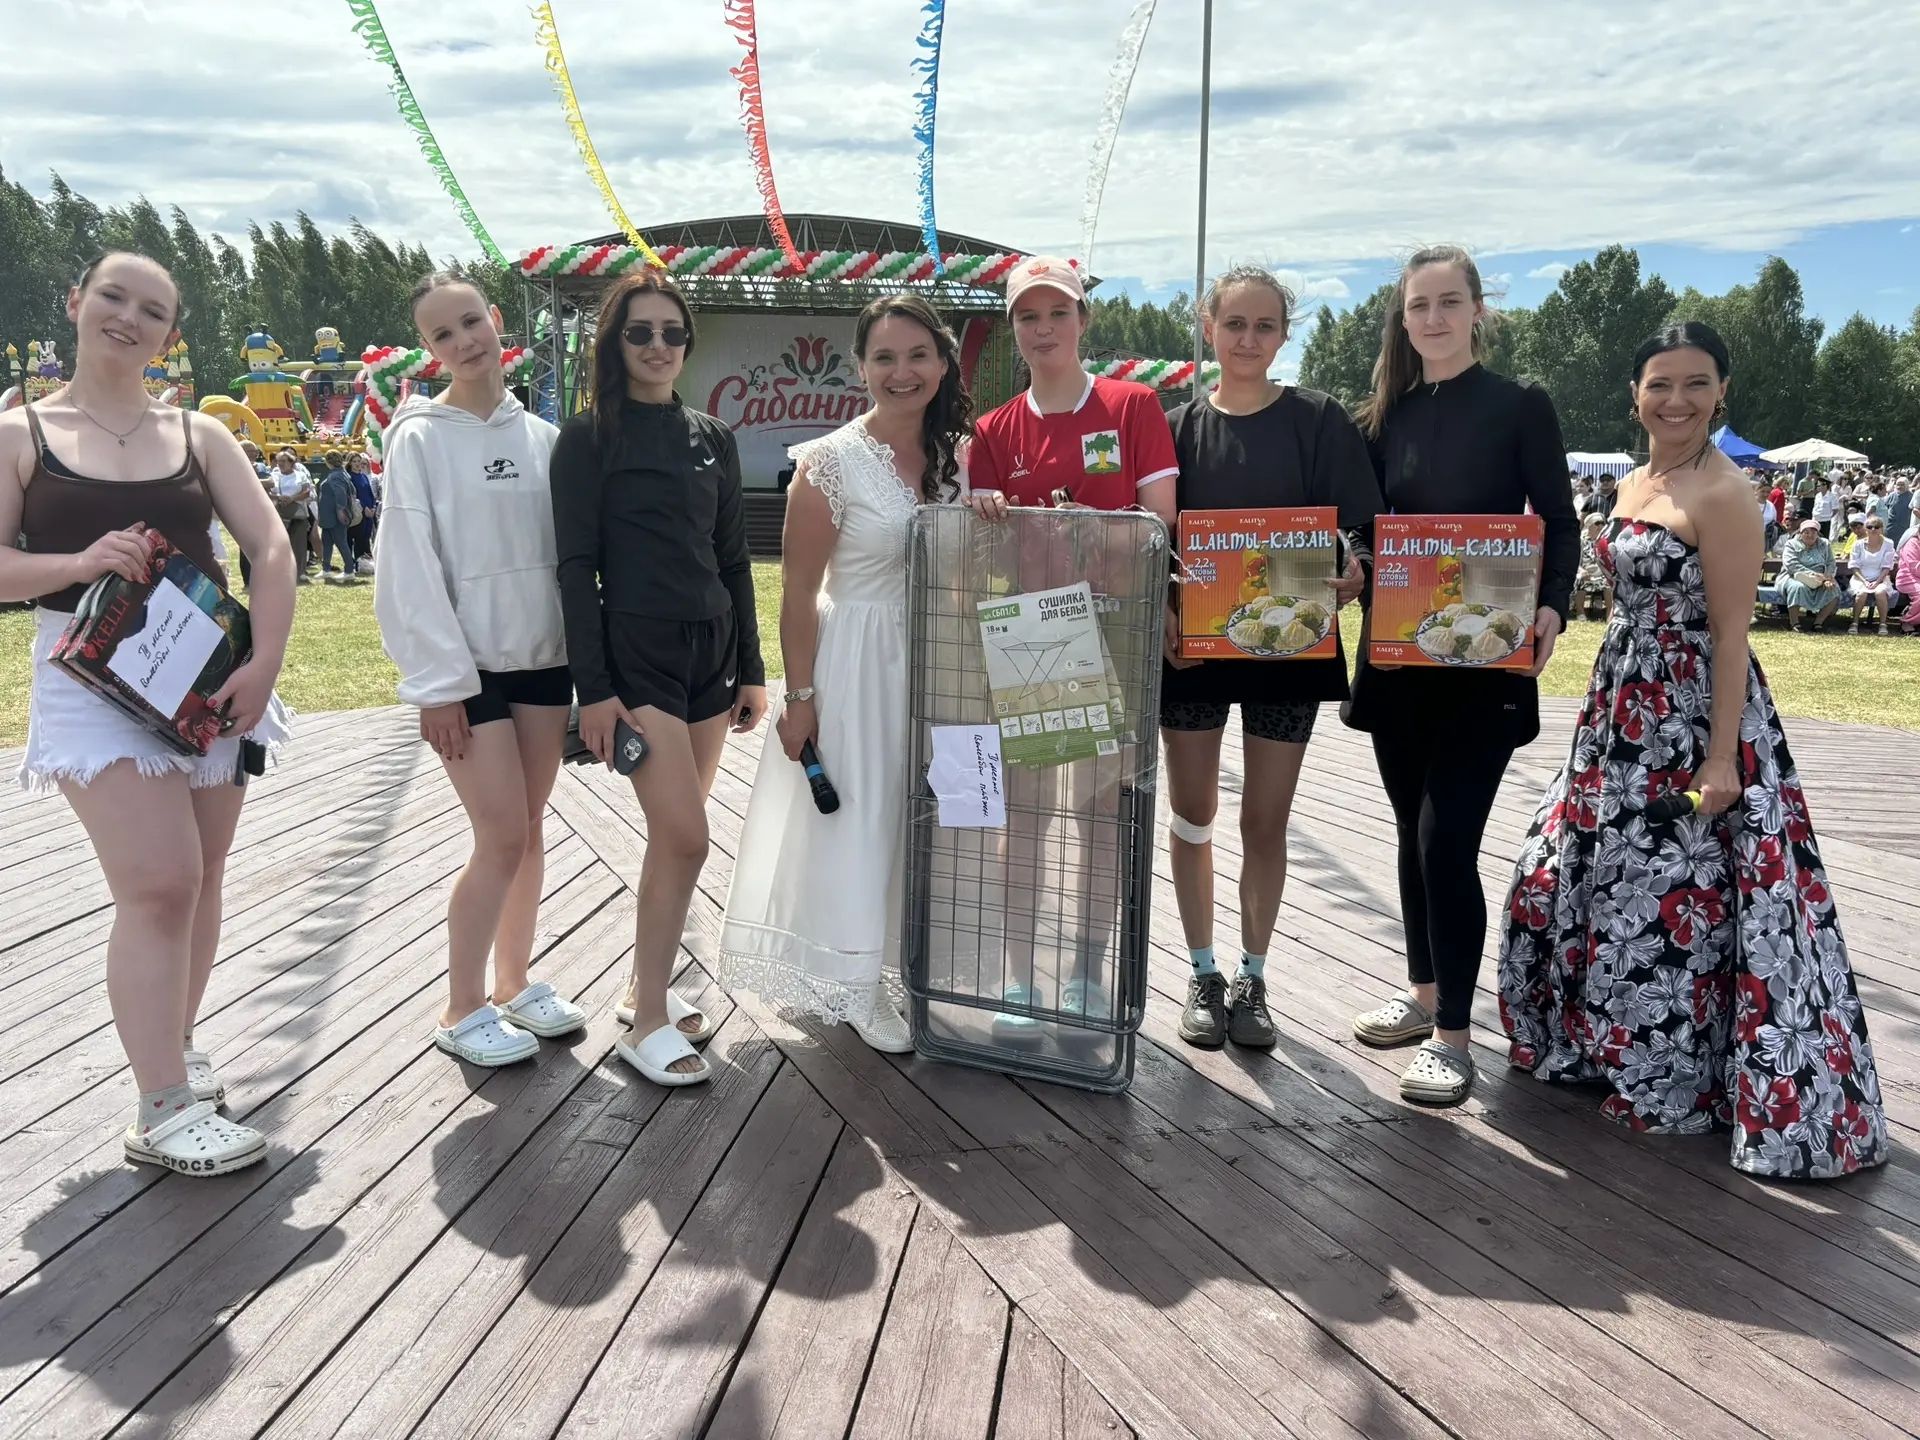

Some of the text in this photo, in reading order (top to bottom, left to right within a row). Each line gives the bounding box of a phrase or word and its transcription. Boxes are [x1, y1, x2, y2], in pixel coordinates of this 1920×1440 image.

[707, 375, 876, 432] Сабант
[1377, 573, 1409, 581] ГОТОВЫХ
[1386, 562, 1402, 574] 2,2
[1038, 592, 1086, 610] СУШИЛКА
[1041, 608, 1059, 622] ДЛЯ
[1060, 603, 1088, 617] БЕЛЬЯ
[92, 594, 130, 653] KELLI
[986, 625, 996, 633] 18
